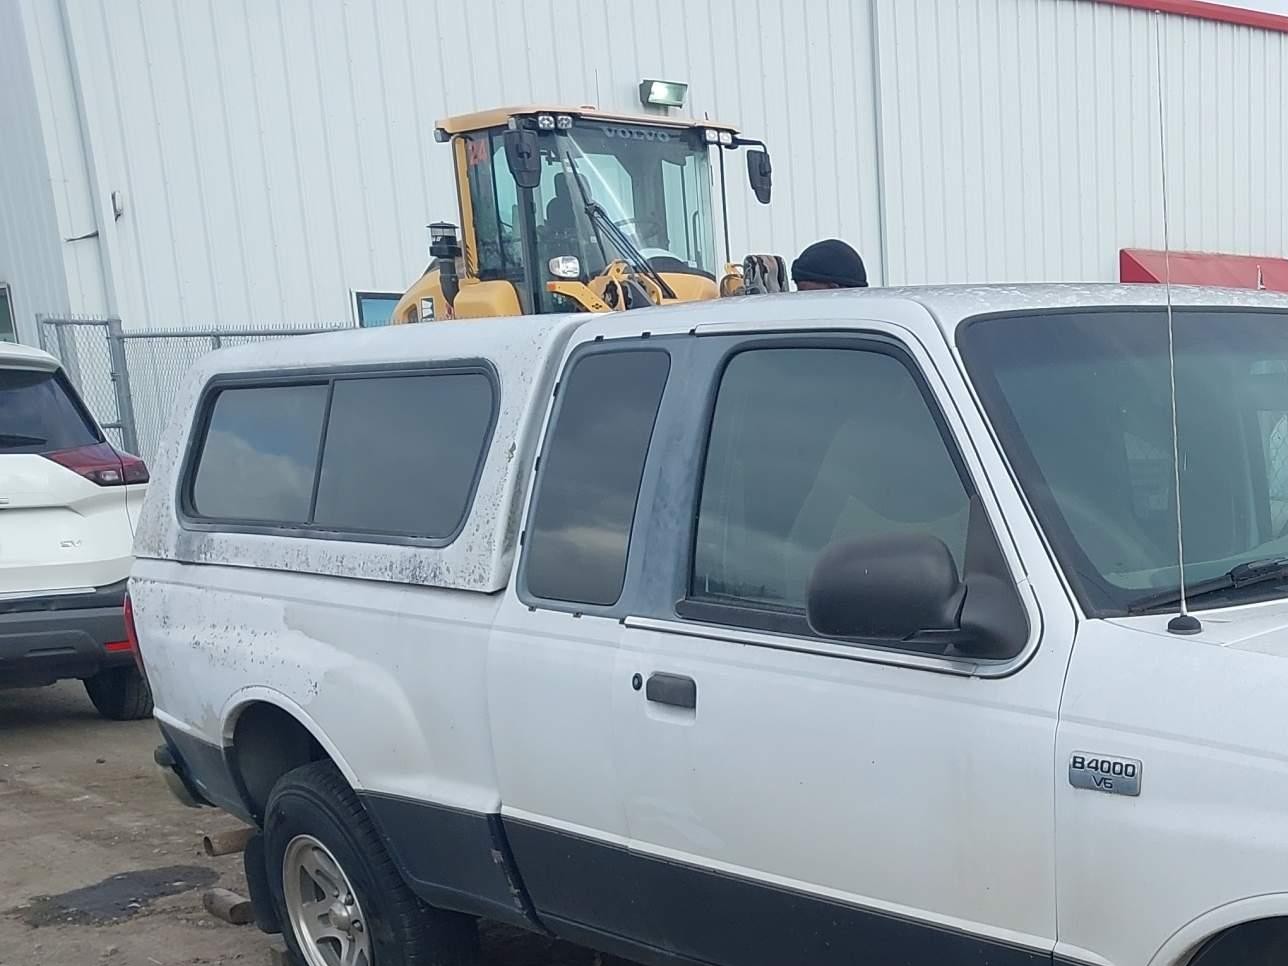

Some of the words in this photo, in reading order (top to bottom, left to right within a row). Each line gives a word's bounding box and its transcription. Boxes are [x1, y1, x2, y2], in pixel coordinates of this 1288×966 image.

[602, 125, 671, 143] VOLVO
[1072, 755, 1136, 778] B4000
[1092, 775, 1113, 789] V6
